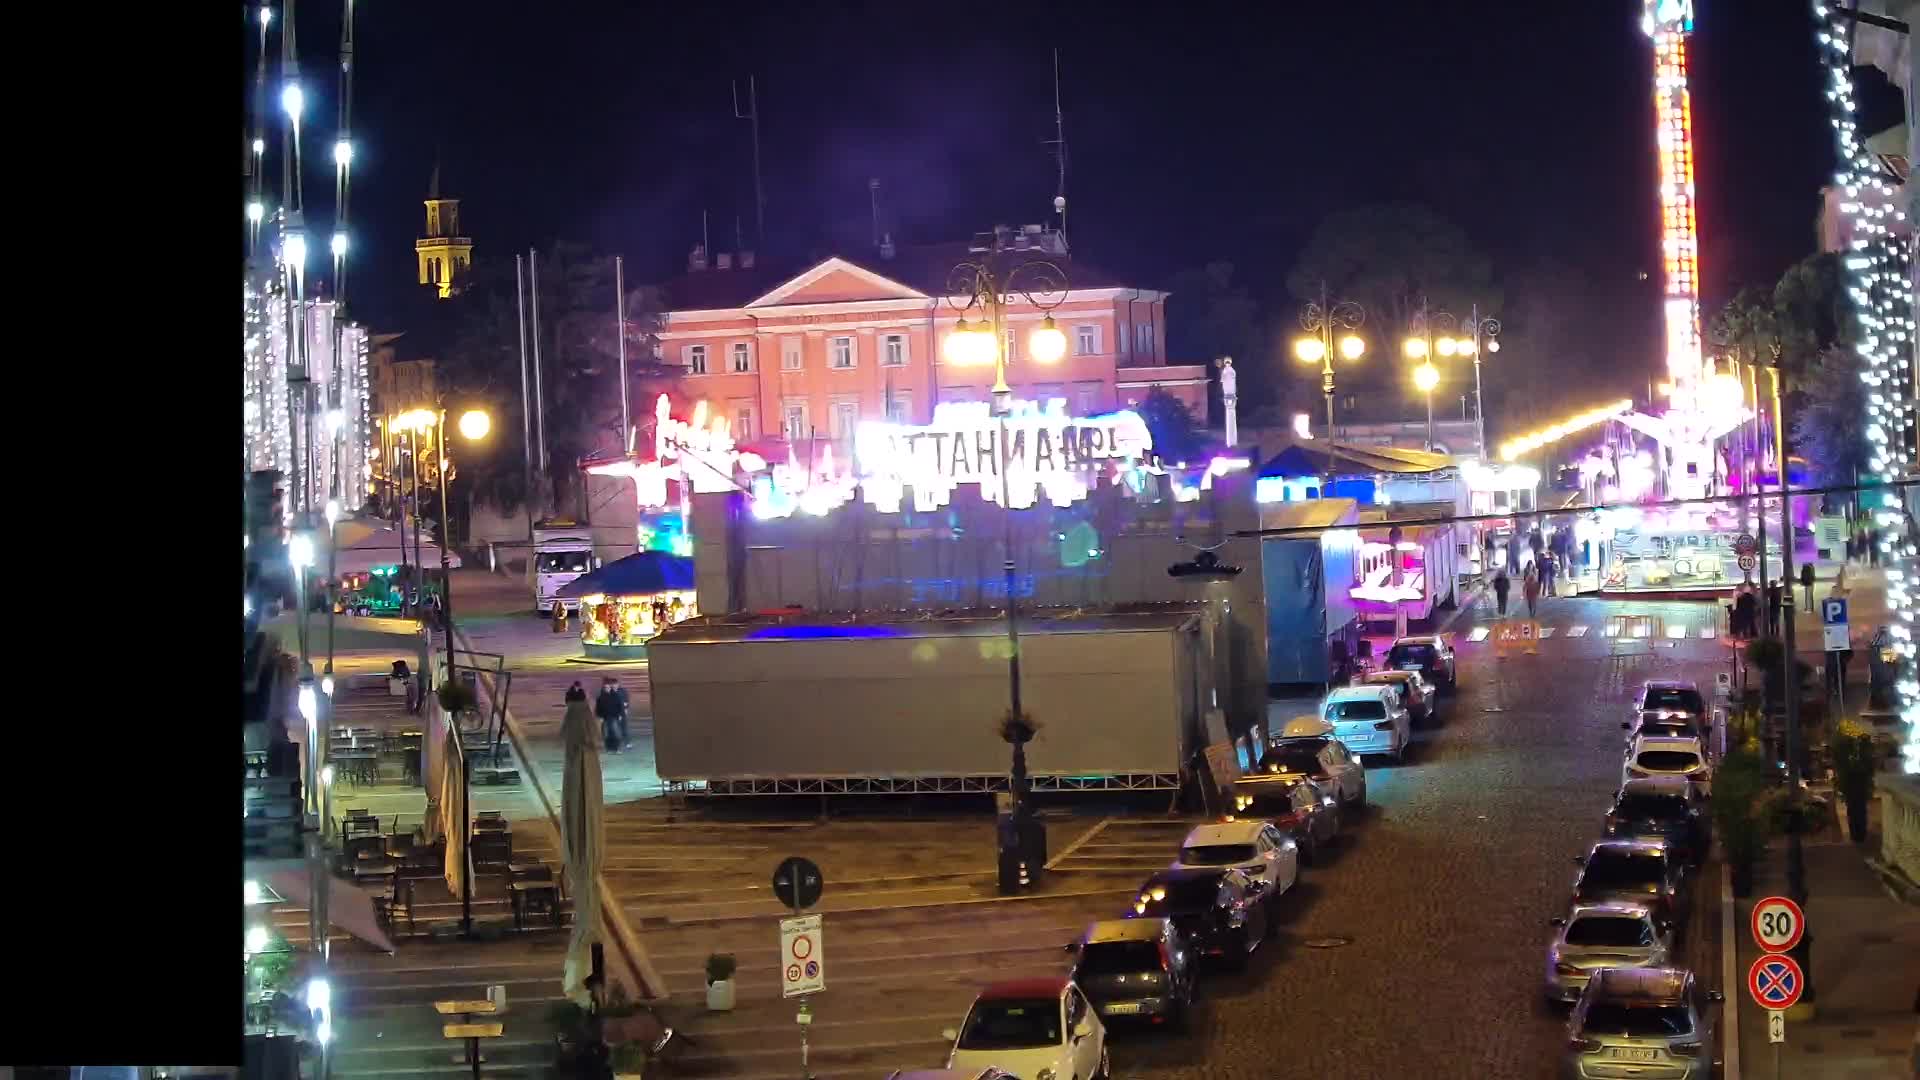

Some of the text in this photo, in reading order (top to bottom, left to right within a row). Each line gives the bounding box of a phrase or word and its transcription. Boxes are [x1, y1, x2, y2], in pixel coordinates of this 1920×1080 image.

[1742, 557, 1753, 567] 20
[1827, 602, 1842, 622] P
[1763, 912, 1791, 937] 30
